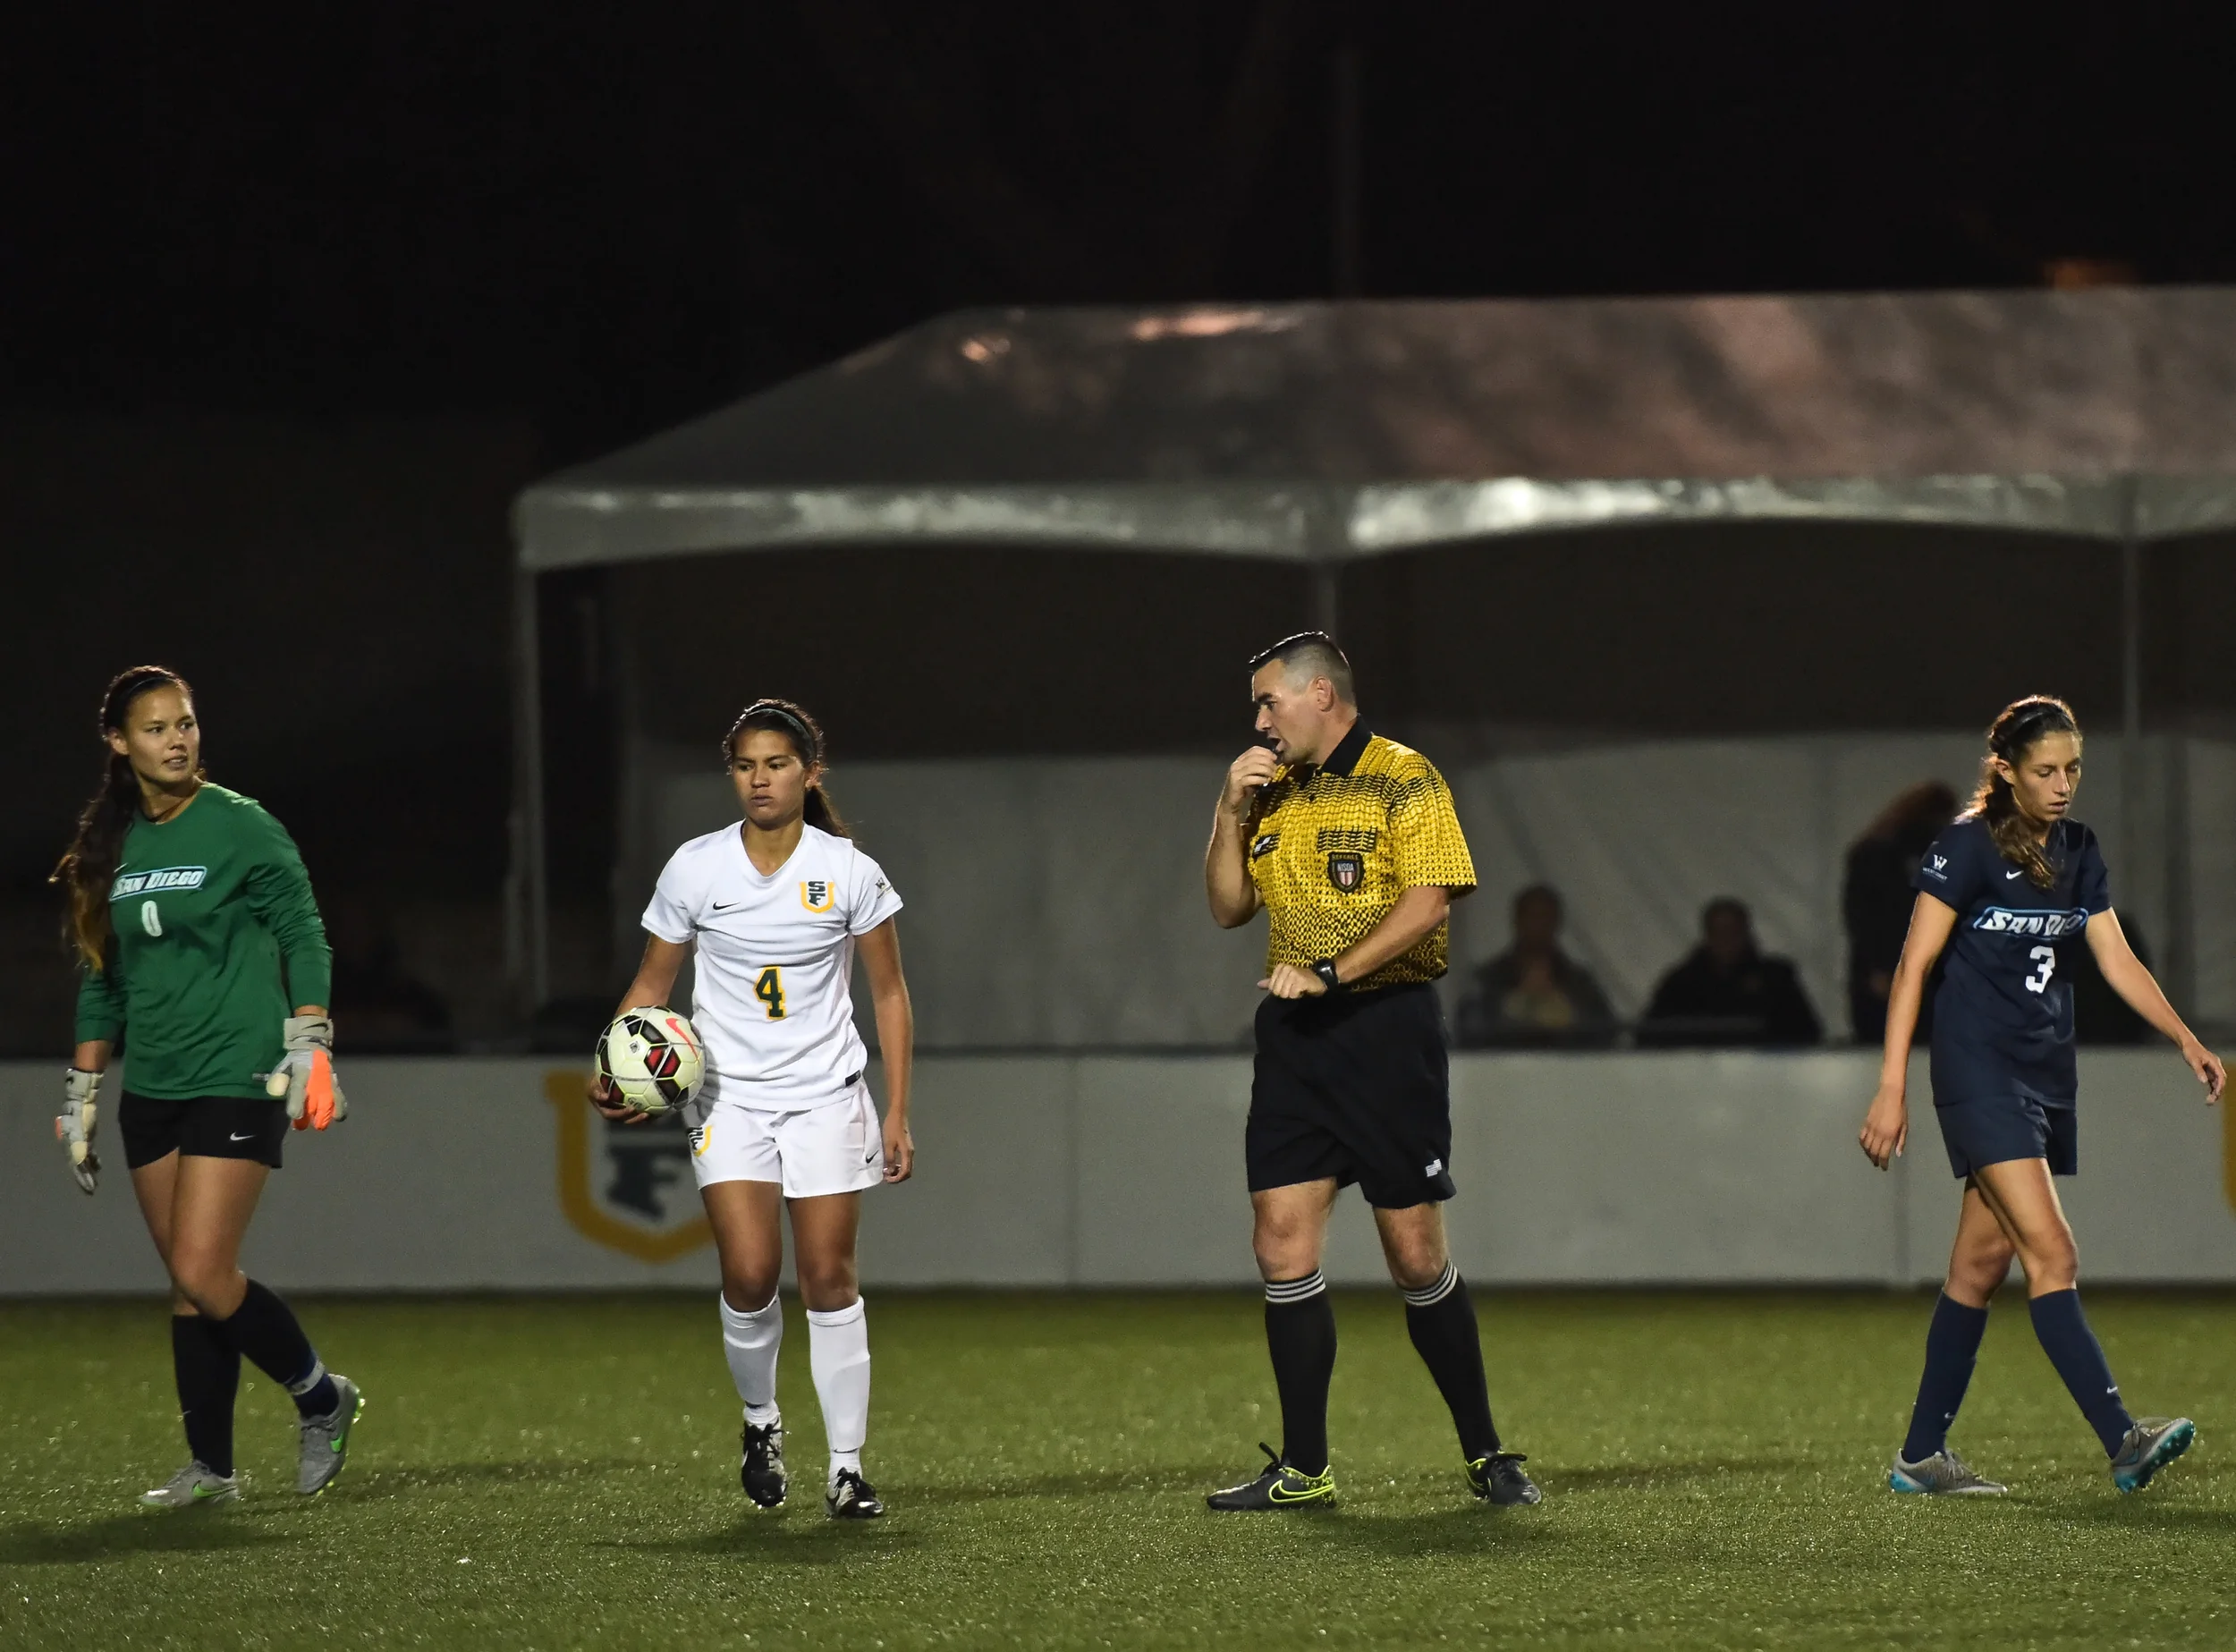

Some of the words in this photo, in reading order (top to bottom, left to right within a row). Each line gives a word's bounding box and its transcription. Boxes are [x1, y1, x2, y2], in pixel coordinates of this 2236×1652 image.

[112, 877, 147, 897] SAN
[143, 870, 204, 890] DIEGO
[141, 900, 163, 937] 0
[1978, 911, 2044, 935] SAN
[2025, 945, 2055, 994] 3
[753, 966, 786, 1021] 4
